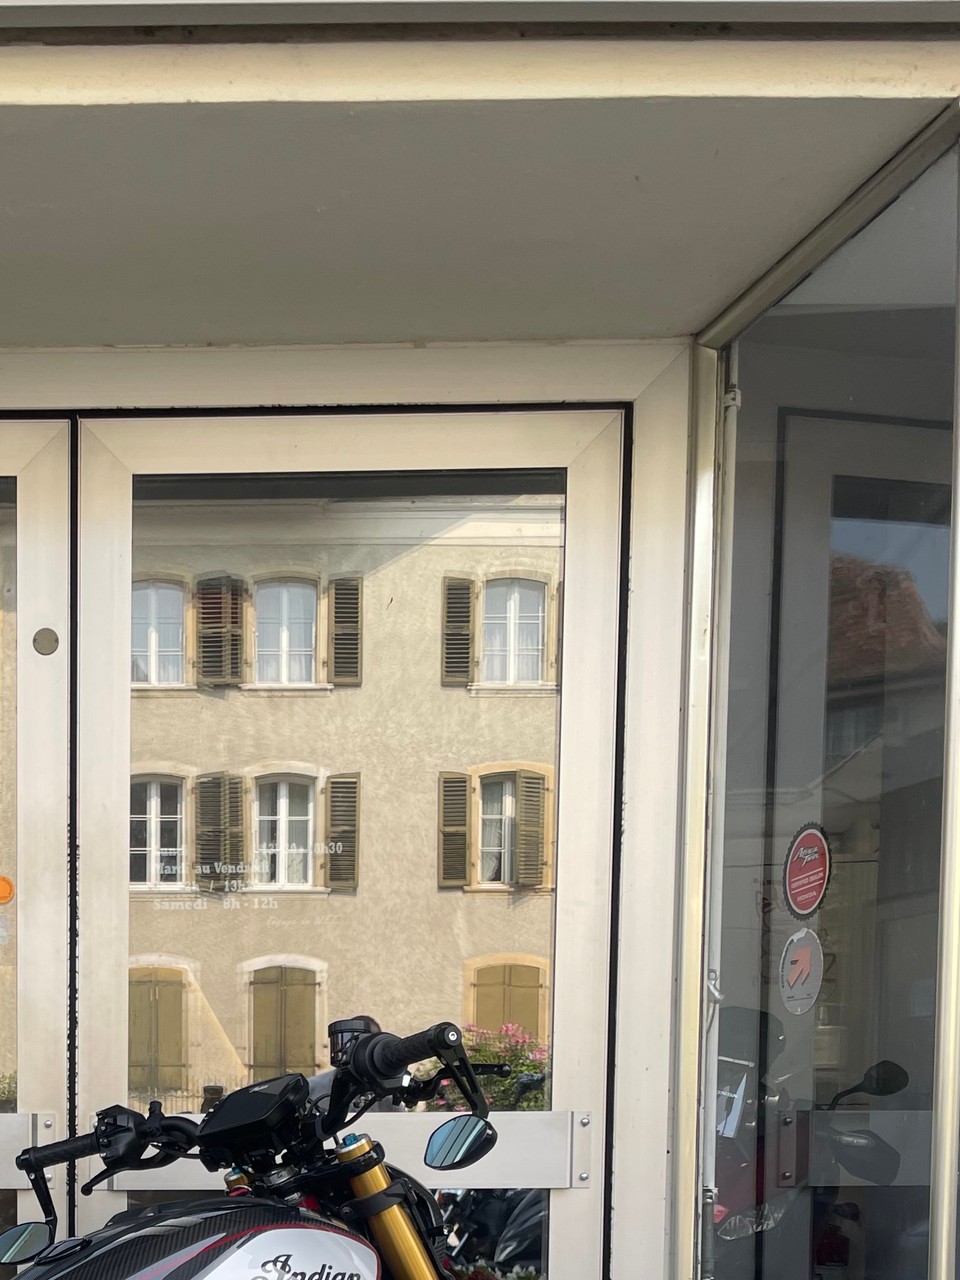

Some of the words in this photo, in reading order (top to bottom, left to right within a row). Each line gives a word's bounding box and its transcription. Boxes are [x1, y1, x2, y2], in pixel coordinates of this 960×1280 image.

[195, 866, 210, 874] au
[153, 898, 208, 911] Samedi
[223, 898, 240, 909] 8h
[253, 898, 279, 909] 12h
